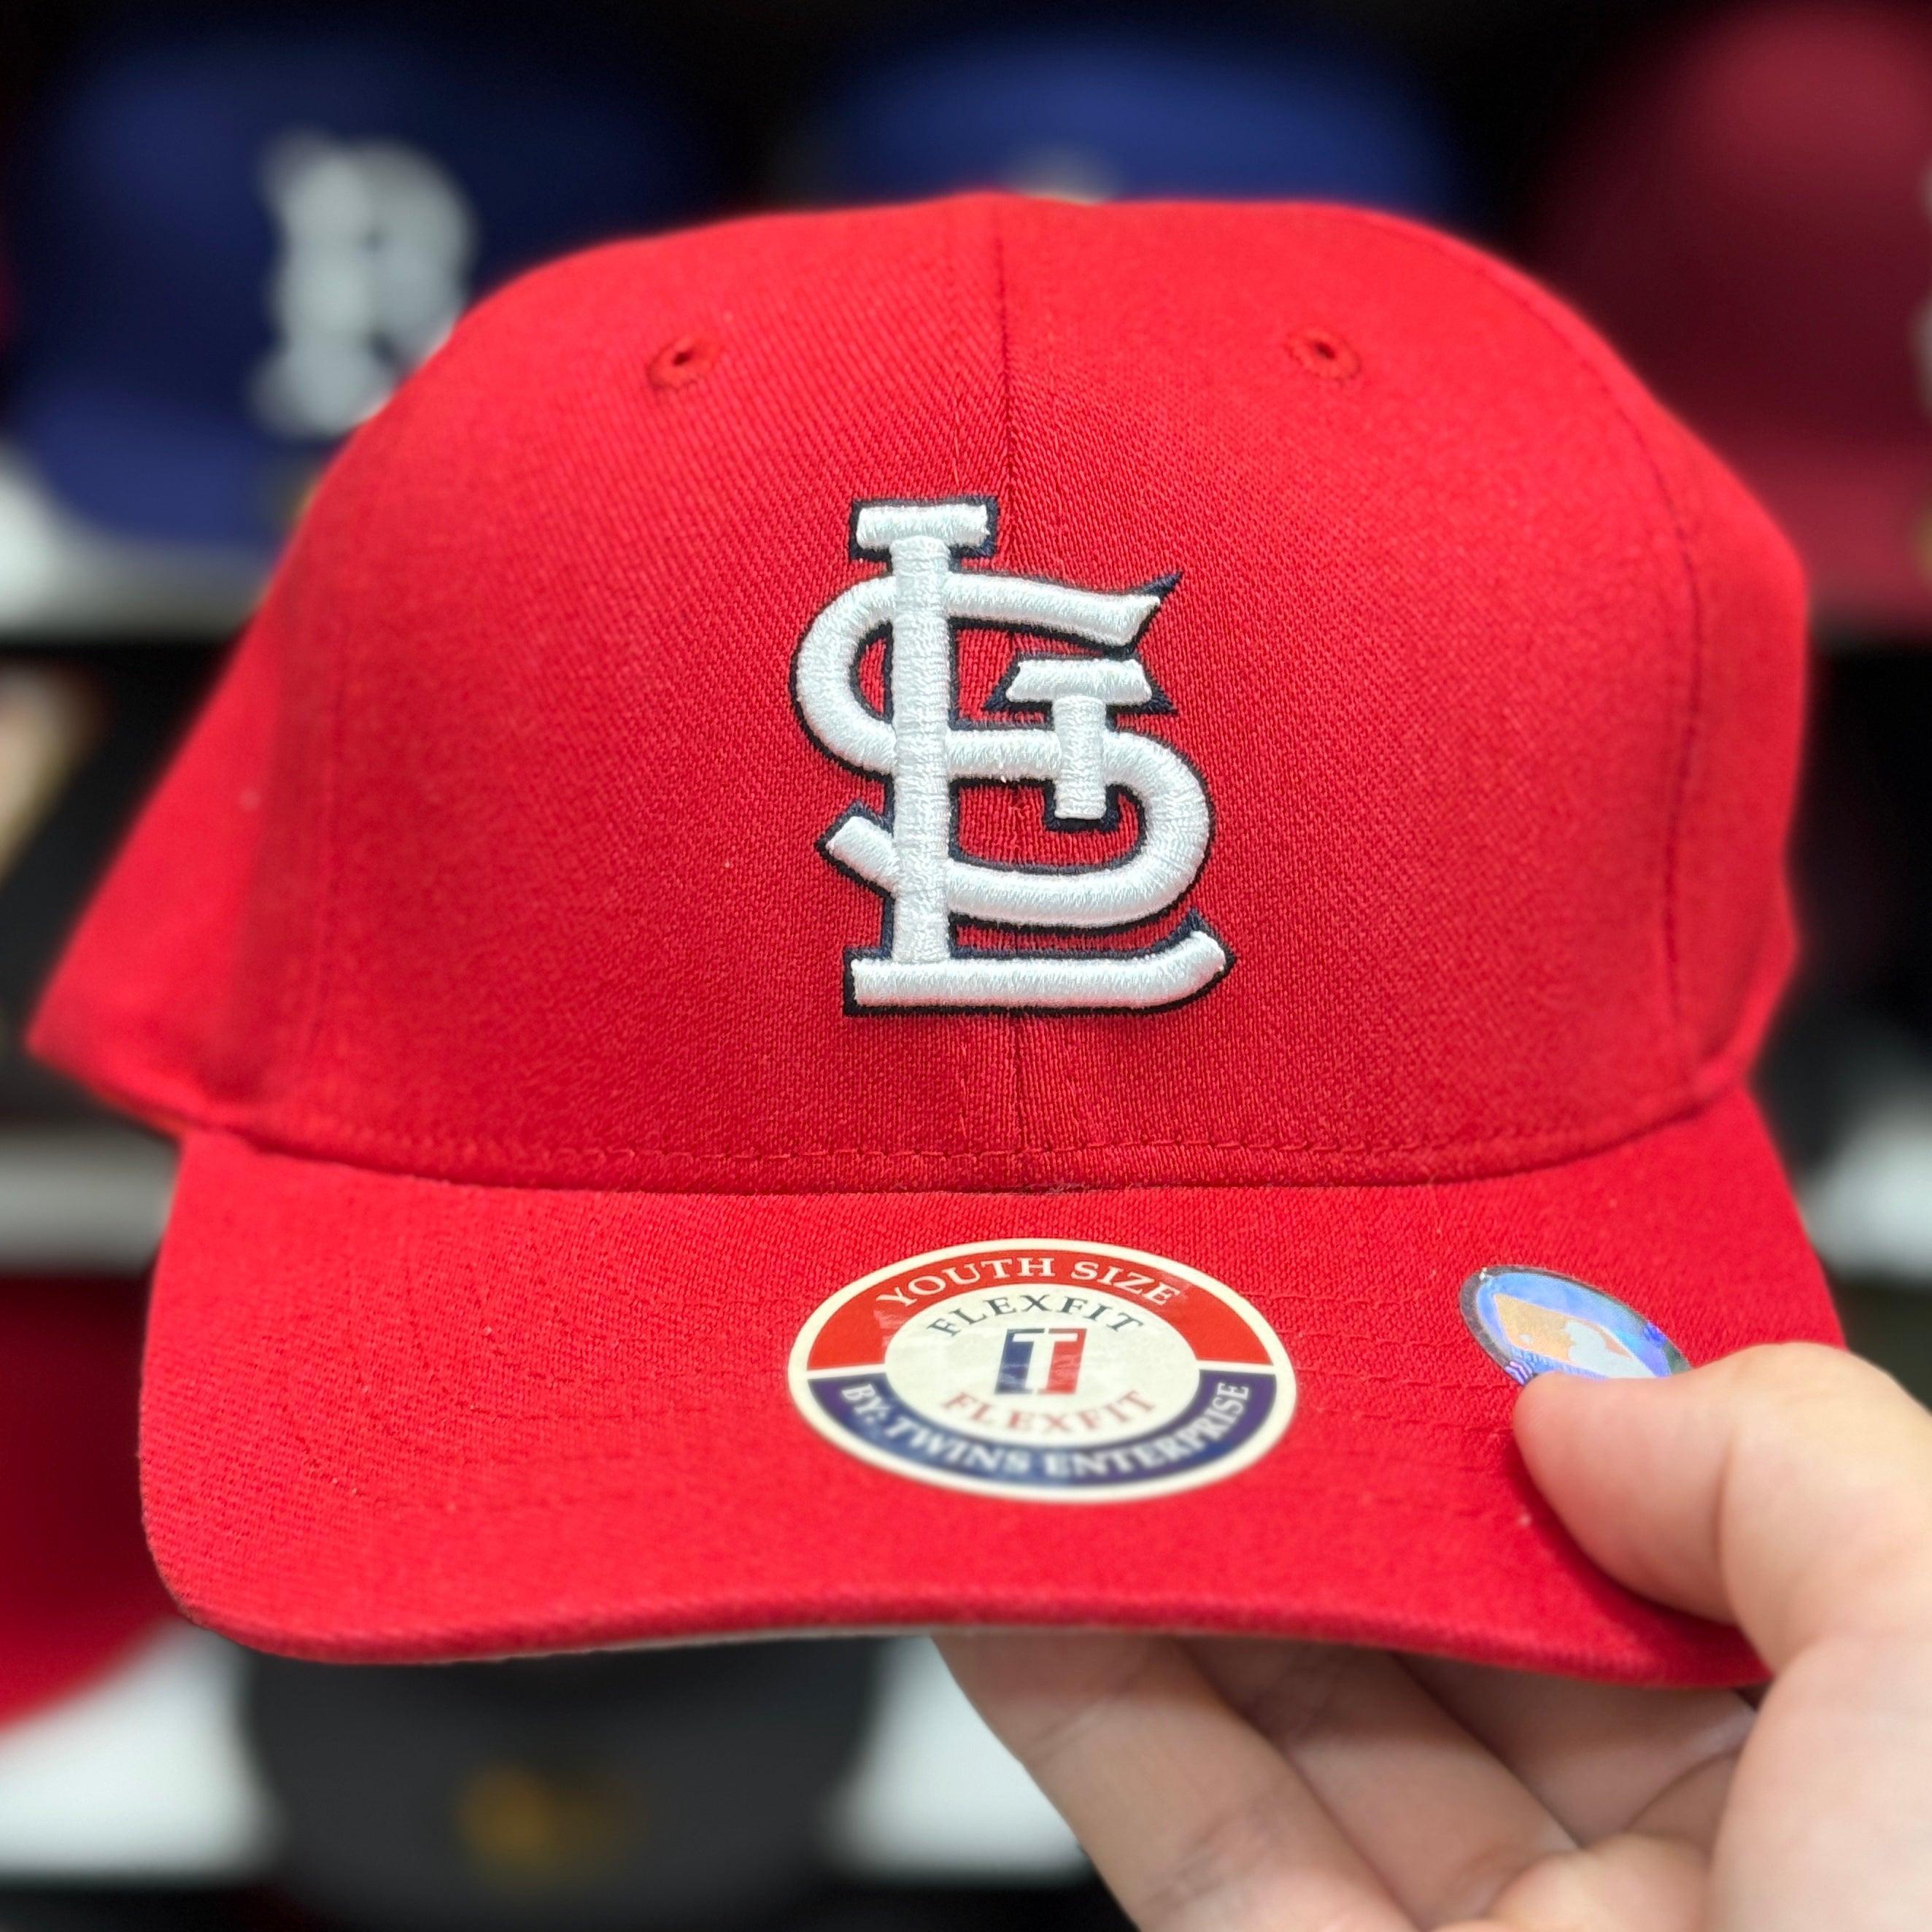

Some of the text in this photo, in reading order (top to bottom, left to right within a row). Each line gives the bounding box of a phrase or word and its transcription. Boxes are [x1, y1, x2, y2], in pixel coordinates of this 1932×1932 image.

[875, 1256, 1181, 1307] YOUTH SIZE
[926, 1294, 1144, 1337] FLEXFIT
[881, 1415, 1032, 1475] TWINS
[1043, 1381, 1250, 1477] ENTERPRISE
[943, 1389, 1156, 1434] FLEXFIT
